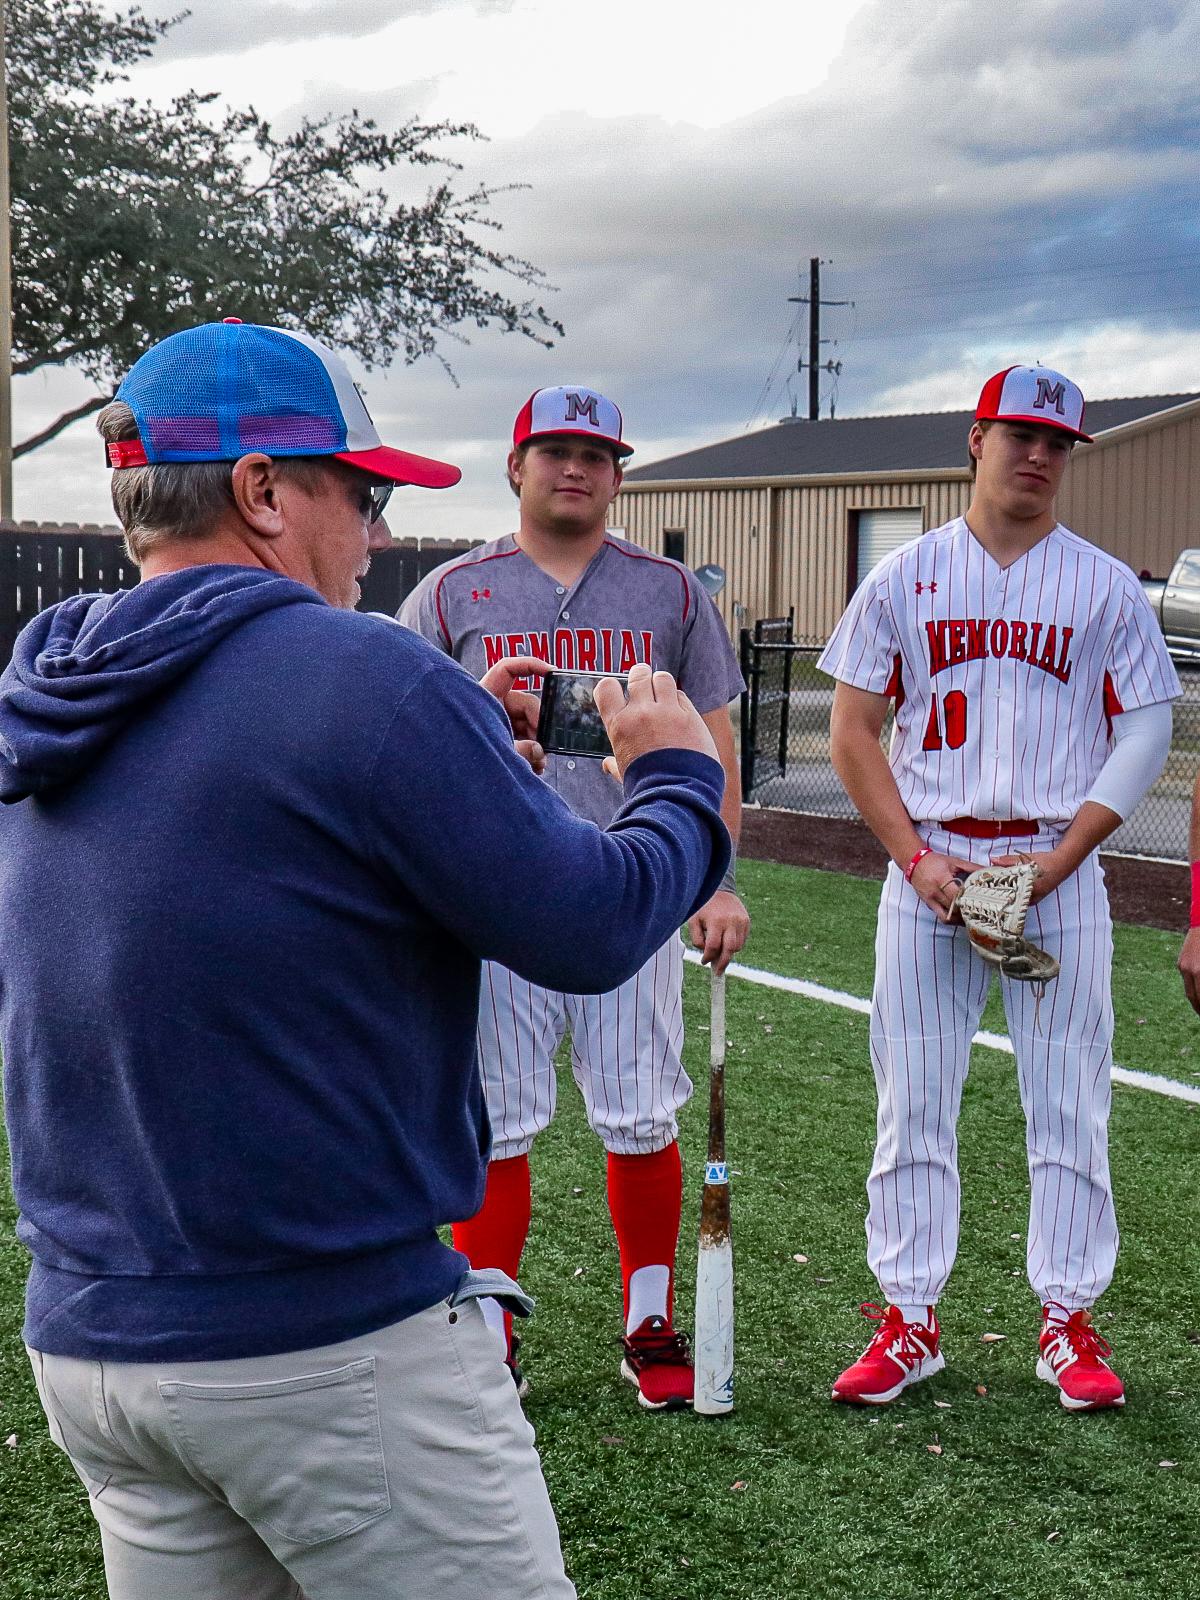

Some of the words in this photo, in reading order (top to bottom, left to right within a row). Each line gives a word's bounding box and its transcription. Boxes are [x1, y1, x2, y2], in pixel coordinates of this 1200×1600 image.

[564, 393, 600, 427] M
[1033, 378, 1066, 415] M
[925, 618, 1074, 685] MEMORIAL
